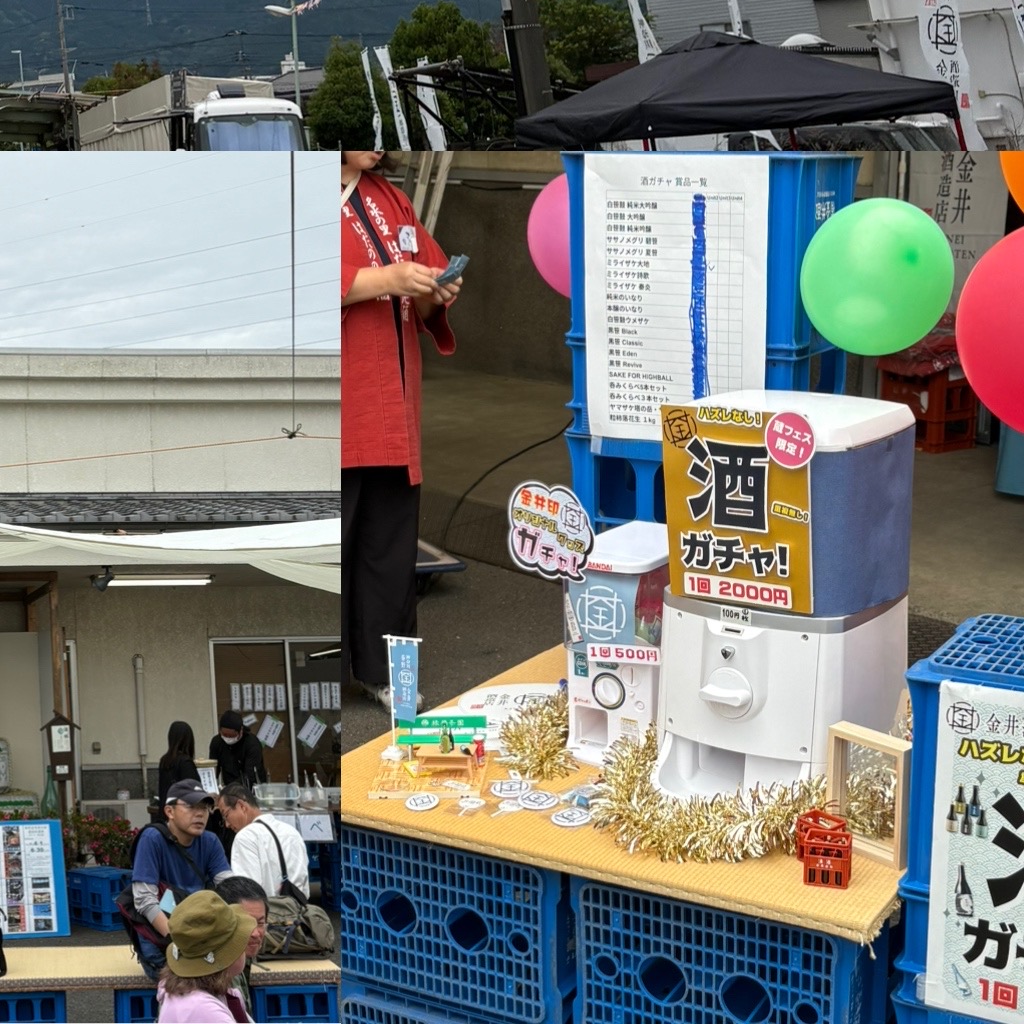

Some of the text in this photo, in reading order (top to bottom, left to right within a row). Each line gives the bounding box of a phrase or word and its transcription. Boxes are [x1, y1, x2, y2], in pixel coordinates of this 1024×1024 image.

[640, 176, 707, 187] 酒ガチャ 賞品一覧
[951, 151, 977, 225] 金井
[621, 327, 638, 335] Black
[622, 339, 643, 347] Classic
[622, 350, 638, 358] Eden
[623, 361, 642, 369] Revive
[609, 371, 674, 382] SAKE FOR HIGHBALL
[773, 420, 812, 445] 蔵フェス
[686, 435, 770, 534] 酒
[521, 489, 560, 516] 金井印
[587, 561, 613, 571] BANDAI
[719, 581, 788, 606] 2000円
[615, 648, 657, 662] 500円
[986, 712, 1024, 736] 金井
[958, 737, 1024, 764] ハズレ
[963, 919, 1024, 970] ガ
[979, 978, 1018, 1010] 1回
